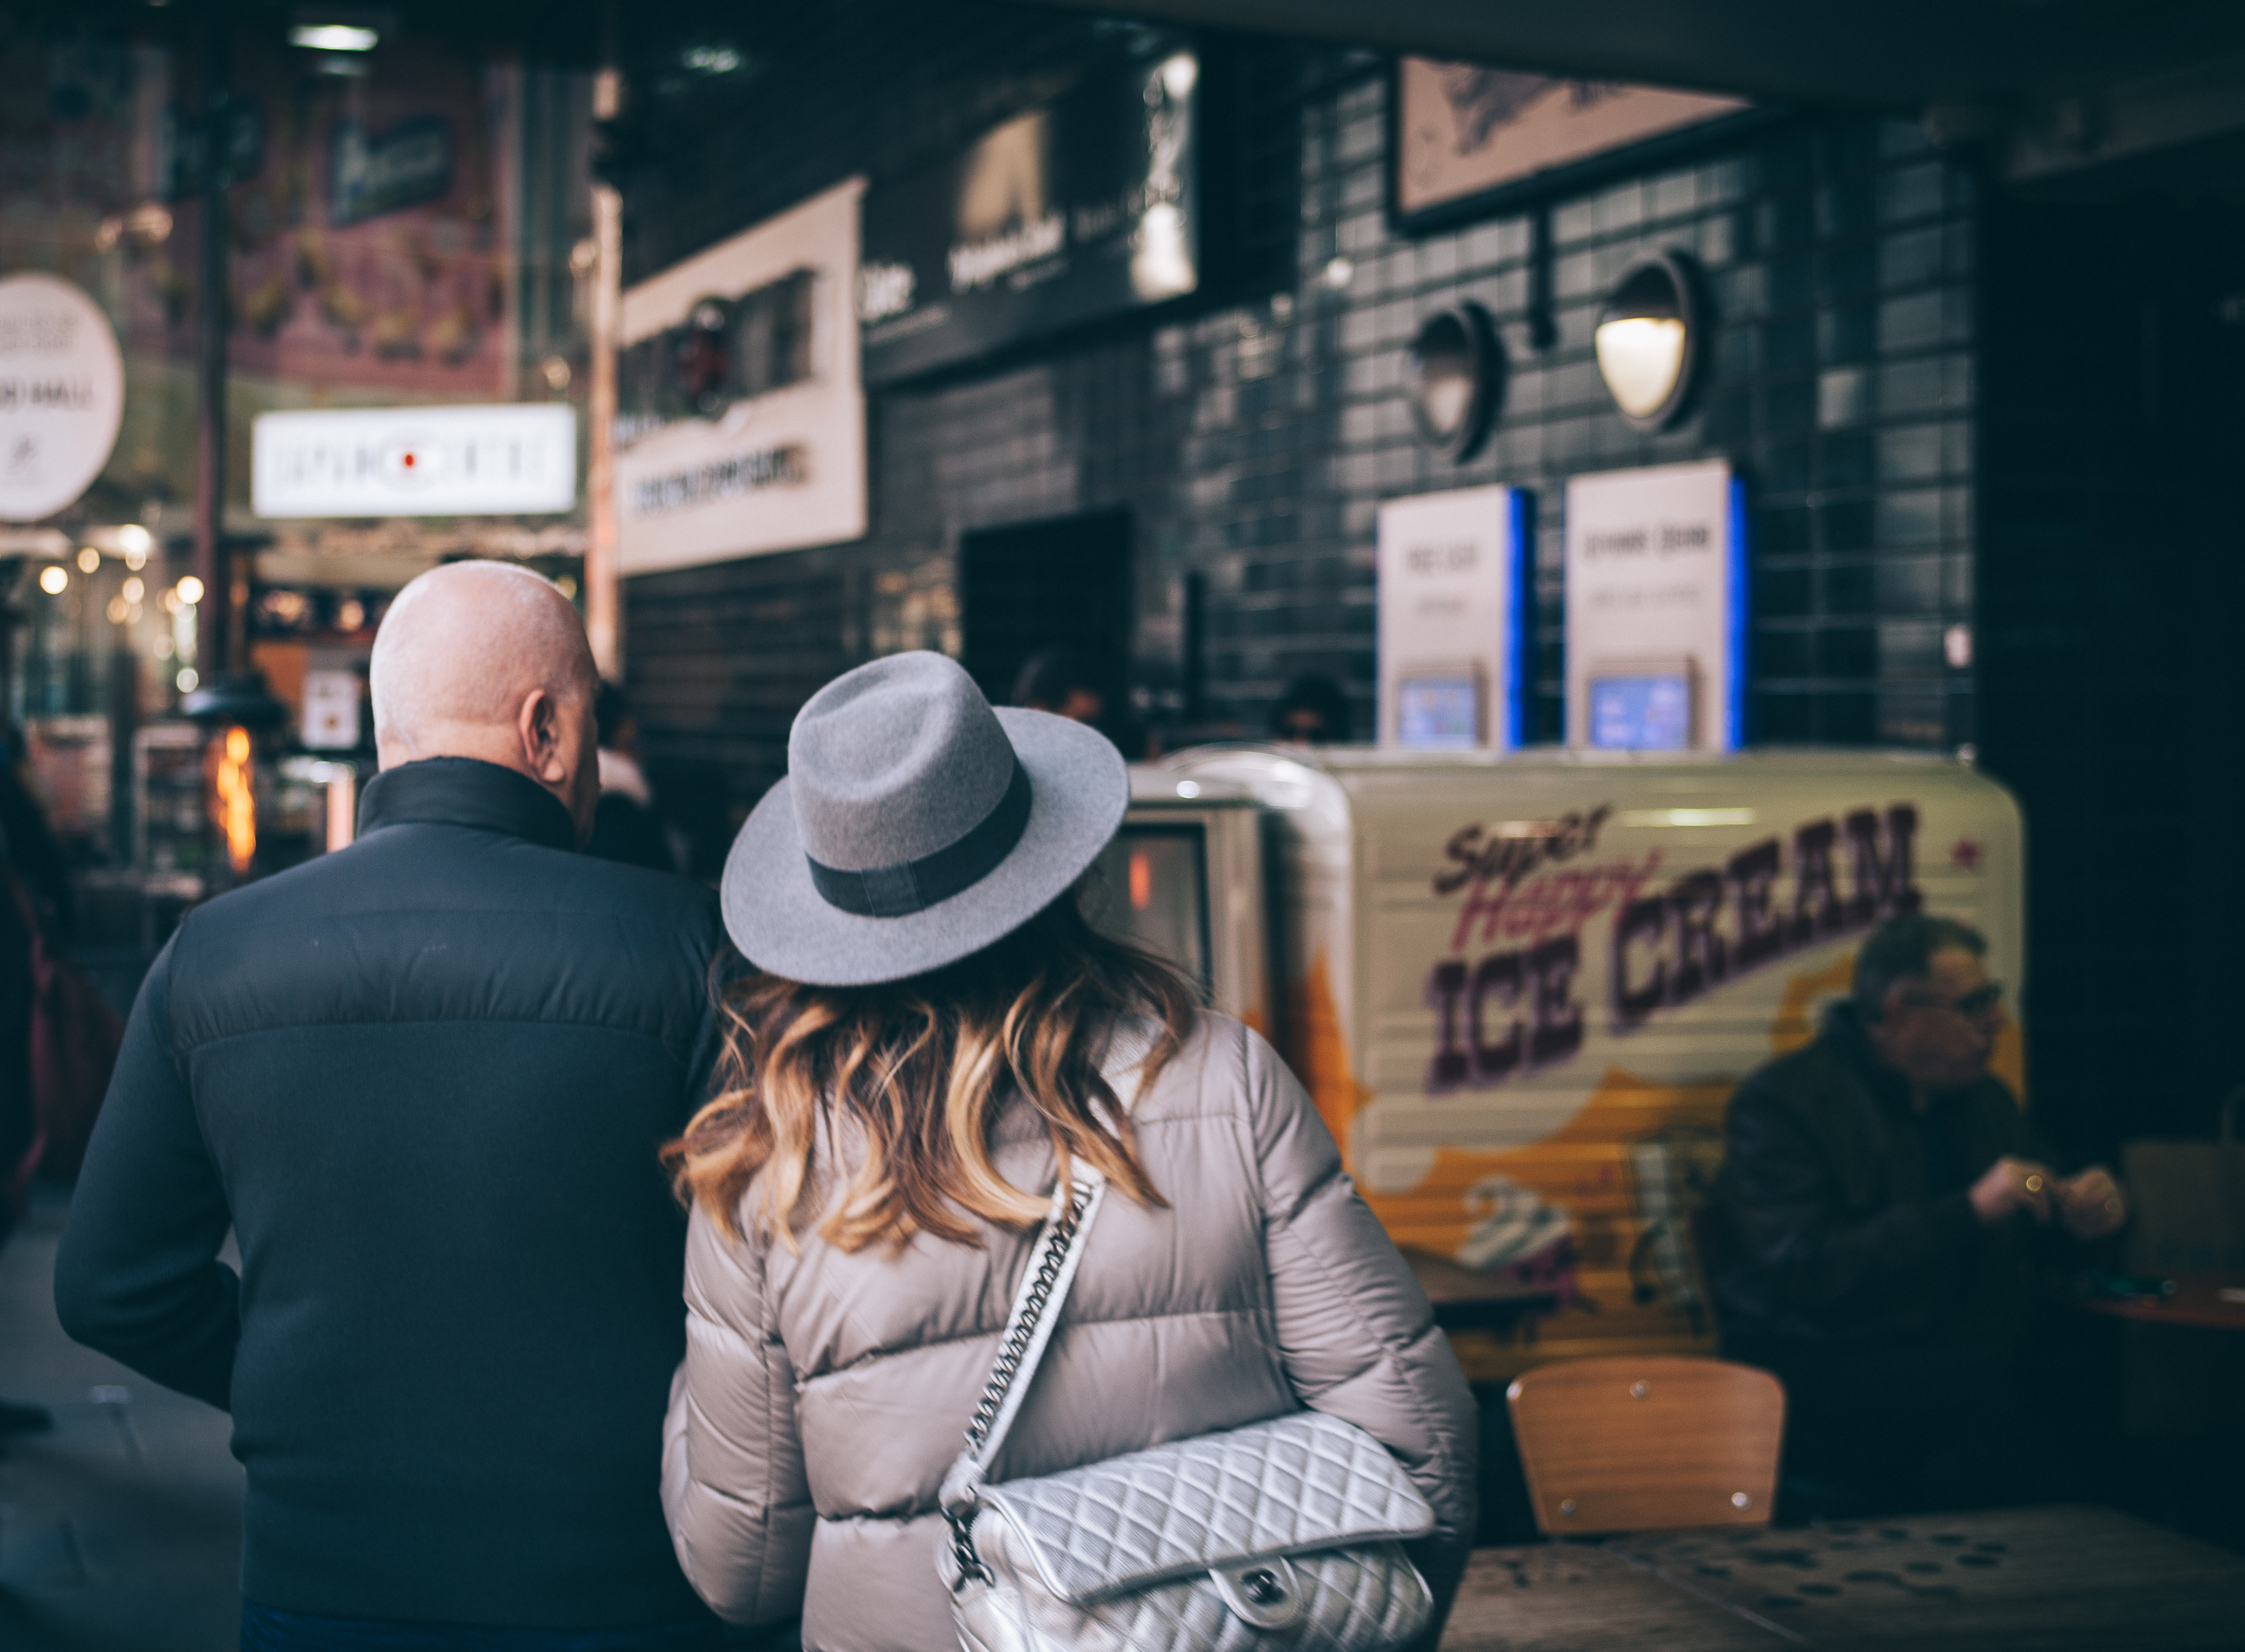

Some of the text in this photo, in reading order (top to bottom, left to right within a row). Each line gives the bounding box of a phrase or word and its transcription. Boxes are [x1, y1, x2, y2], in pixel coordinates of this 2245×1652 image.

[1435, 804, 1614, 892] Super
[1450, 845, 1663, 951] Happy
[1427, 803, 1922, 1098] ICE CREAM
